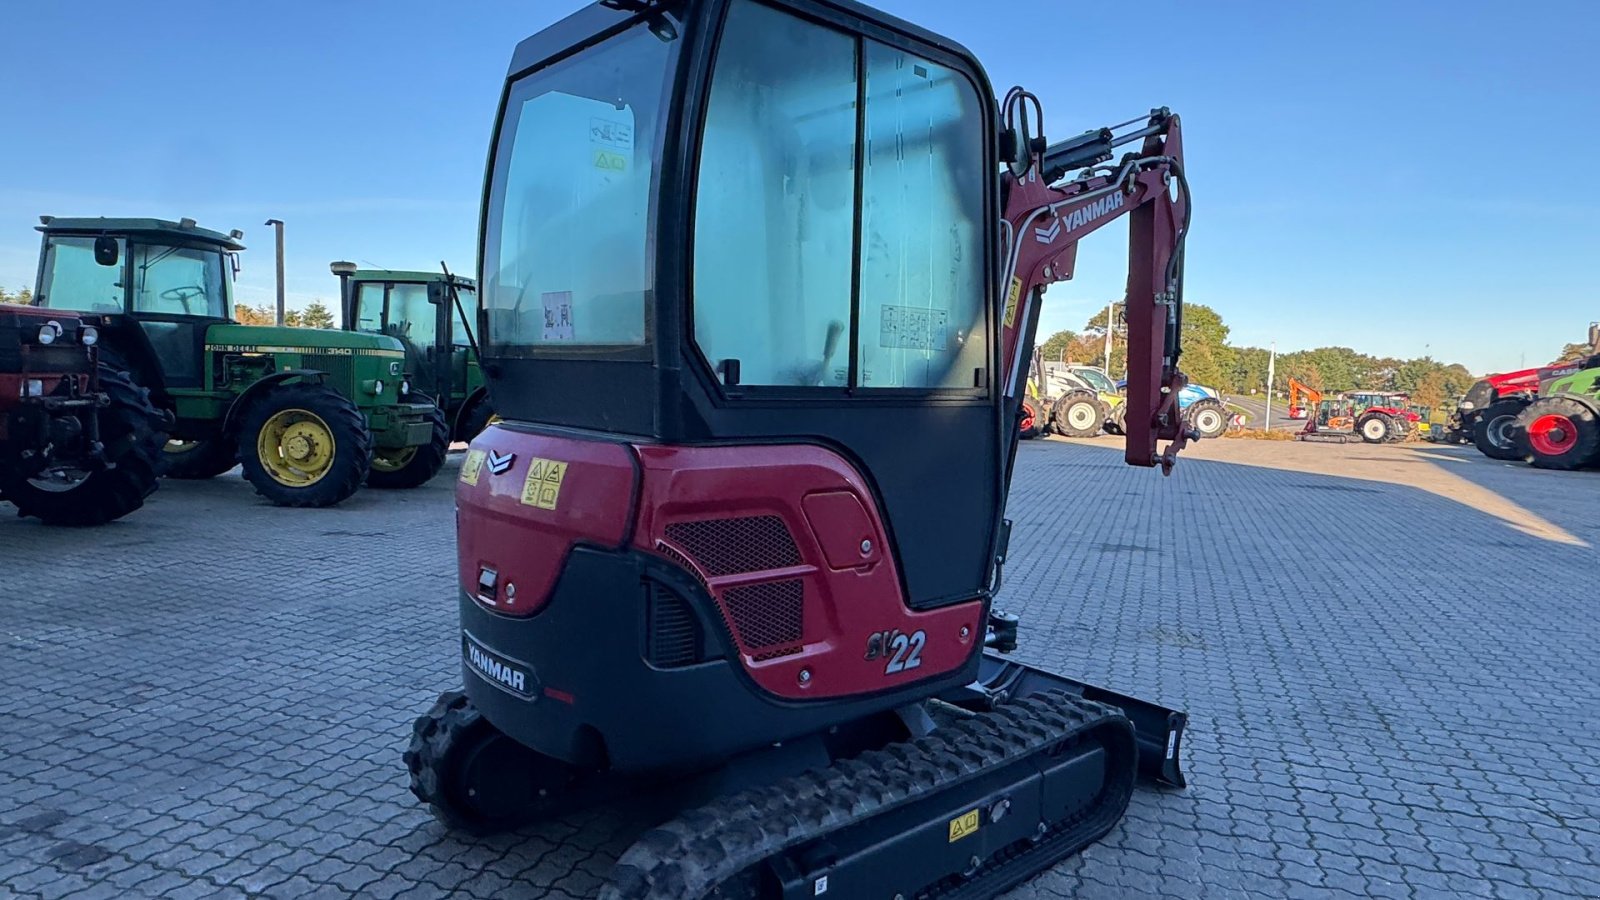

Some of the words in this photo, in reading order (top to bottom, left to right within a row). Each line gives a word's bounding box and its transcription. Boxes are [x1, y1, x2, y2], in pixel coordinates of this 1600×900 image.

[1062, 189, 1124, 233] YANMAR
[208, 344, 228, 352] JOHN
[232, 344, 257, 353] DEERE
[328, 347, 352, 356] 3140
[468, 642, 525, 691] YANMAR
